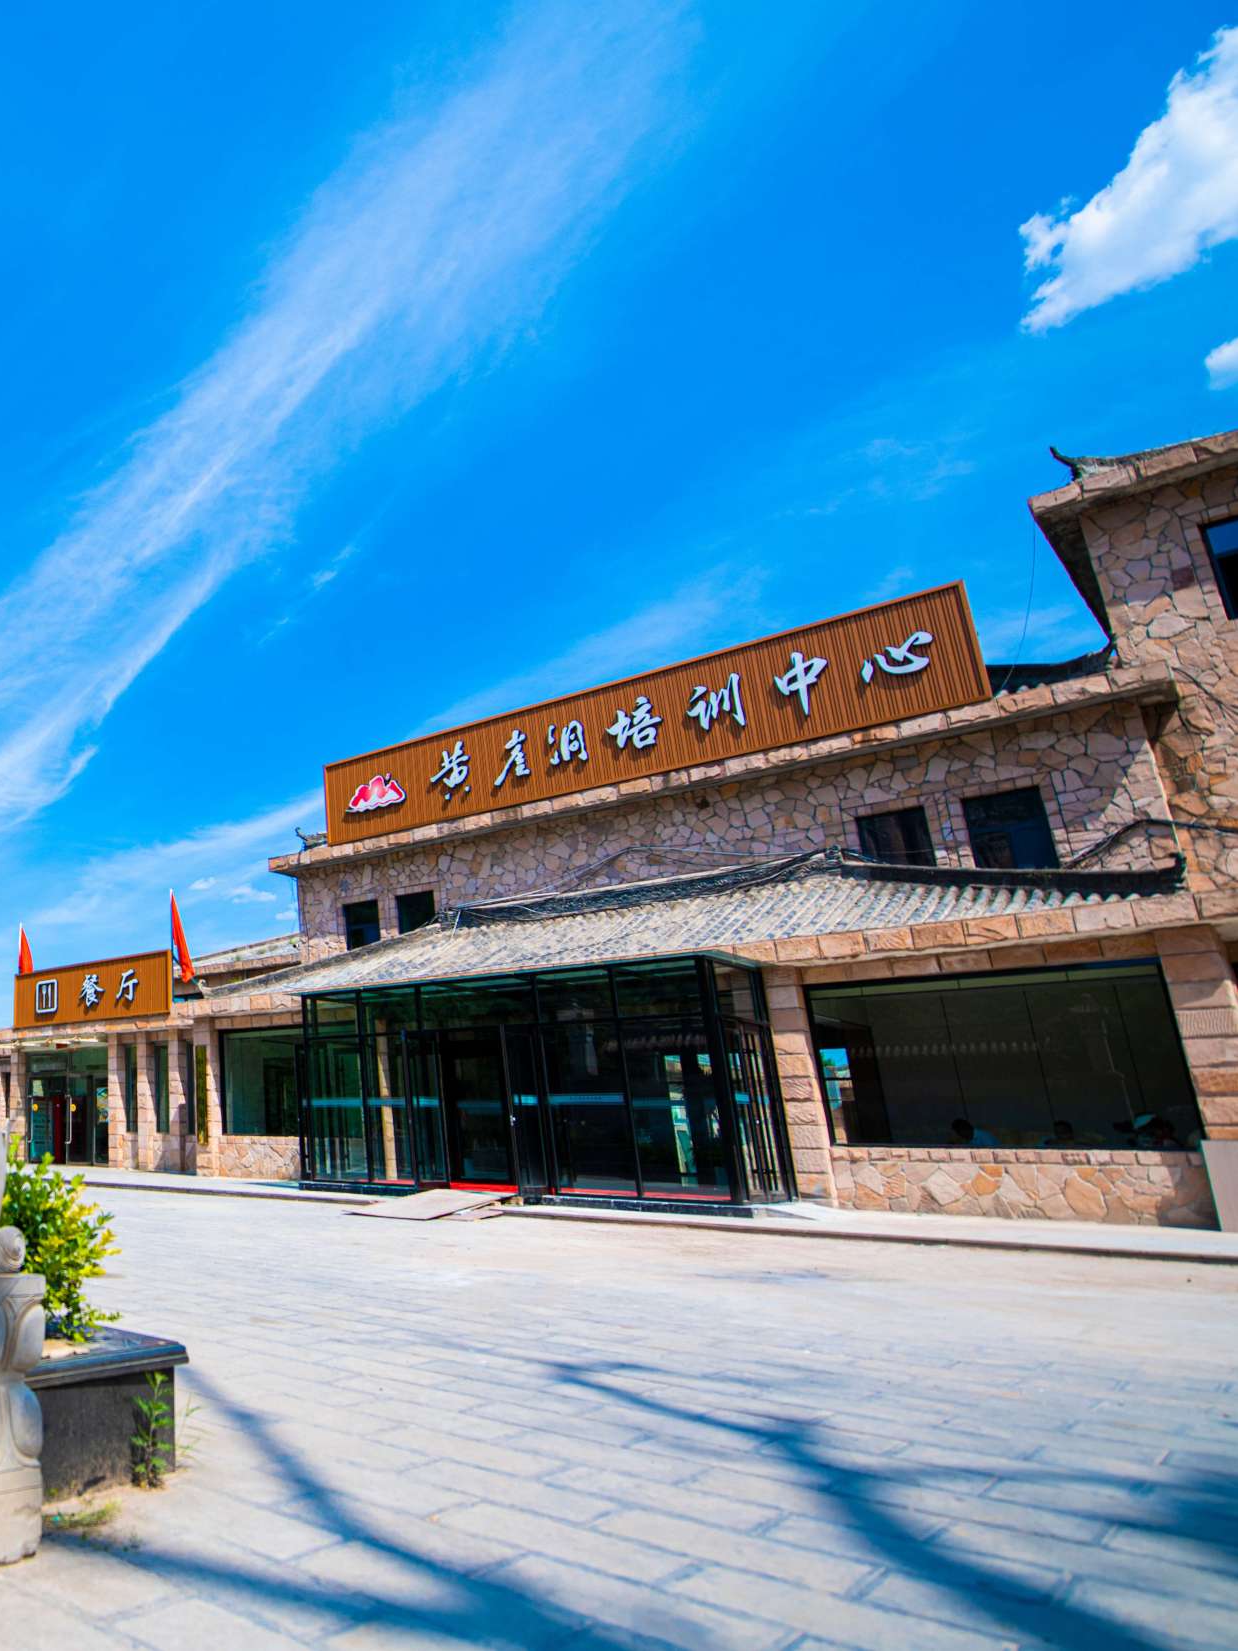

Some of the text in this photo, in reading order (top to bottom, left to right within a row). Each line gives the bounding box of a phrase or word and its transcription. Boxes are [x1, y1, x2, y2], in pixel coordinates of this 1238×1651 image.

[430, 630, 934, 799] 黄崖洞培训中心
[78, 969, 139, 1008] 餐厅
